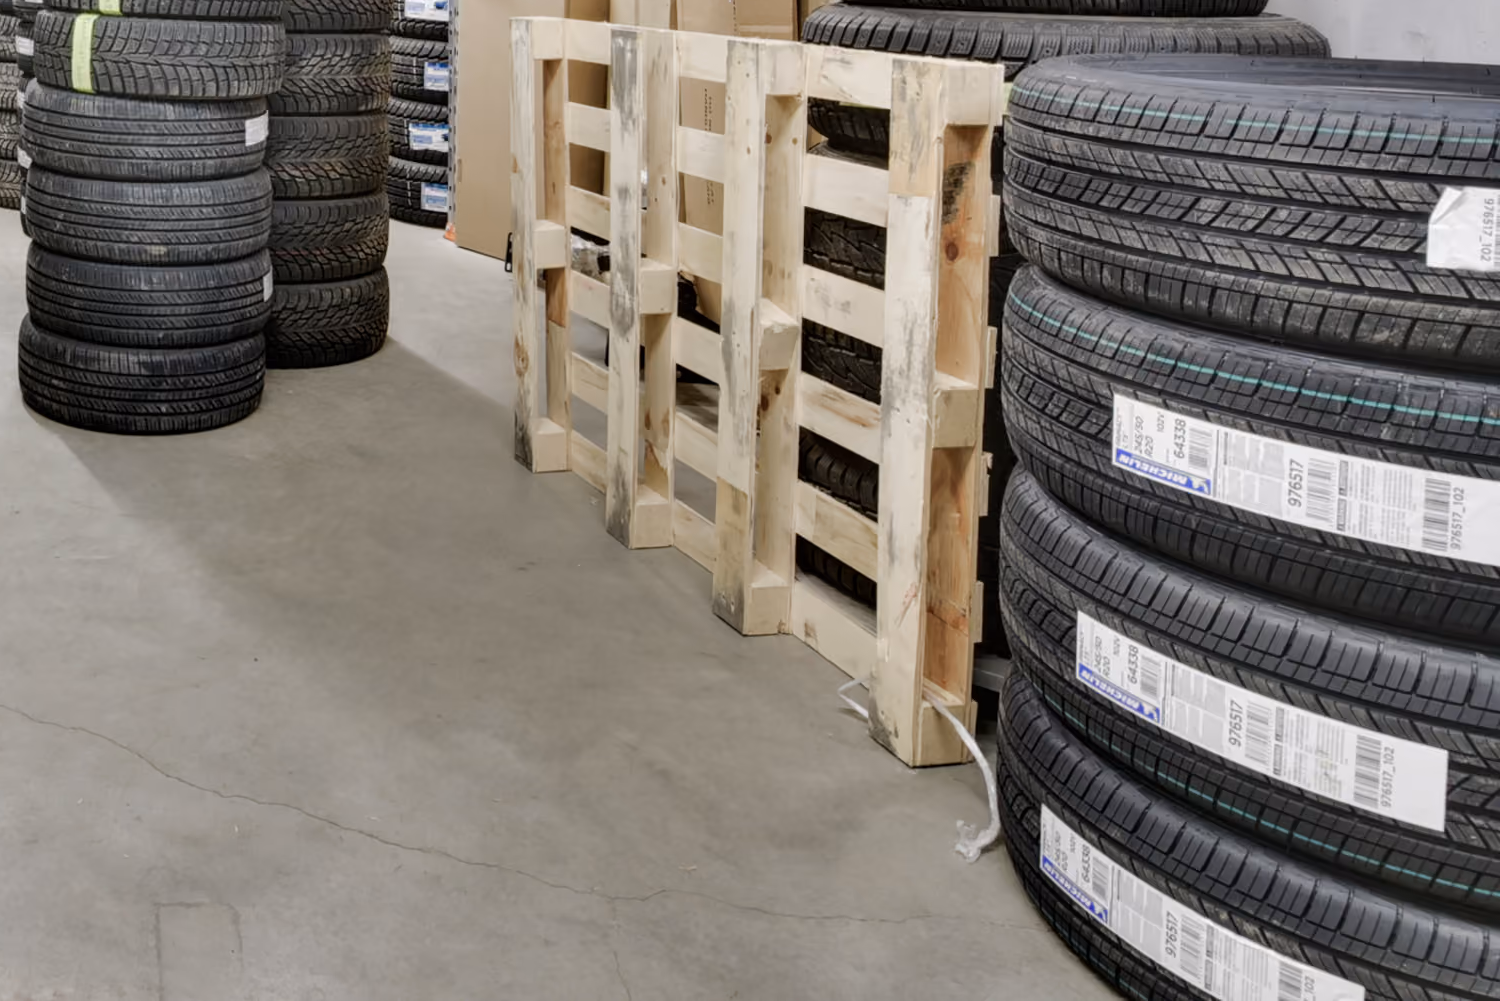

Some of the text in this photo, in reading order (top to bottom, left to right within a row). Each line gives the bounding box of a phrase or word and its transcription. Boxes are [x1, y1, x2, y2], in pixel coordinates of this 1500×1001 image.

[1479, 198, 1495, 262] 976517_102
[1135, 415, 1144, 454] 245/50
[1144, 435, 1154, 458] R20
[1174, 418, 1186, 459] 64338
[1119, 453, 1188, 484] MICHELIN
[1288, 458, 1304, 507] 976517
[1450, 487, 1466, 551] 976517_102
[1127, 644, 1139, 685] 64338
[1080, 669, 1141, 709] MICHELIN
[1229, 700, 1243, 748] 976517
[1381, 746, 1396, 809] 976517_102
[1043, 861, 1092, 907] MICHELIN
[1165, 910, 1178, 959] 976517
